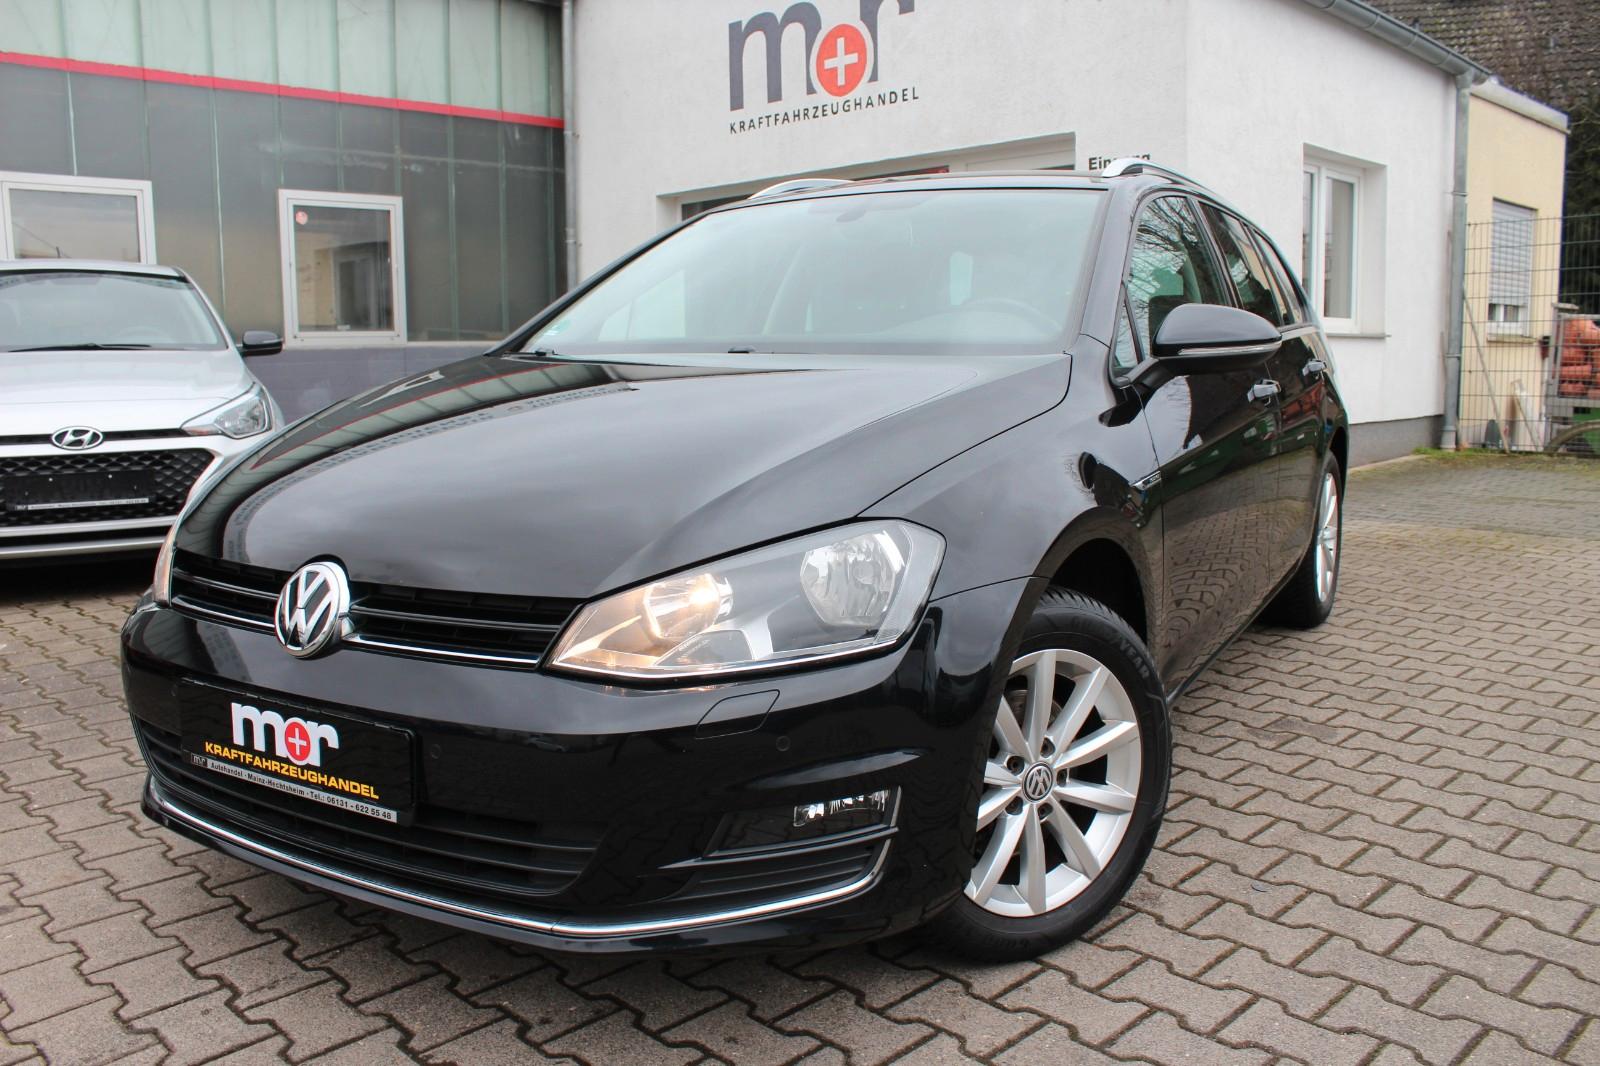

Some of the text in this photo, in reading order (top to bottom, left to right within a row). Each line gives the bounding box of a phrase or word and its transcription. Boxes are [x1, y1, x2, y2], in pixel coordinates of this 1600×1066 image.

[729, 86, 920, 135] KRAFTFAHRZEUGHANDEL
[1088, 152, 1151, 171] Eing
[205, 741, 380, 800] KRAFTFAHRZEUGHANDEL
[247, 772, 305, 796] Mainz-Hechtsheim
[326, 796, 348, 808] 06131
[355, 804, 369, 814] 622
[370, 808, 380, 817] 55
[381, 811, 392, 820] 48
